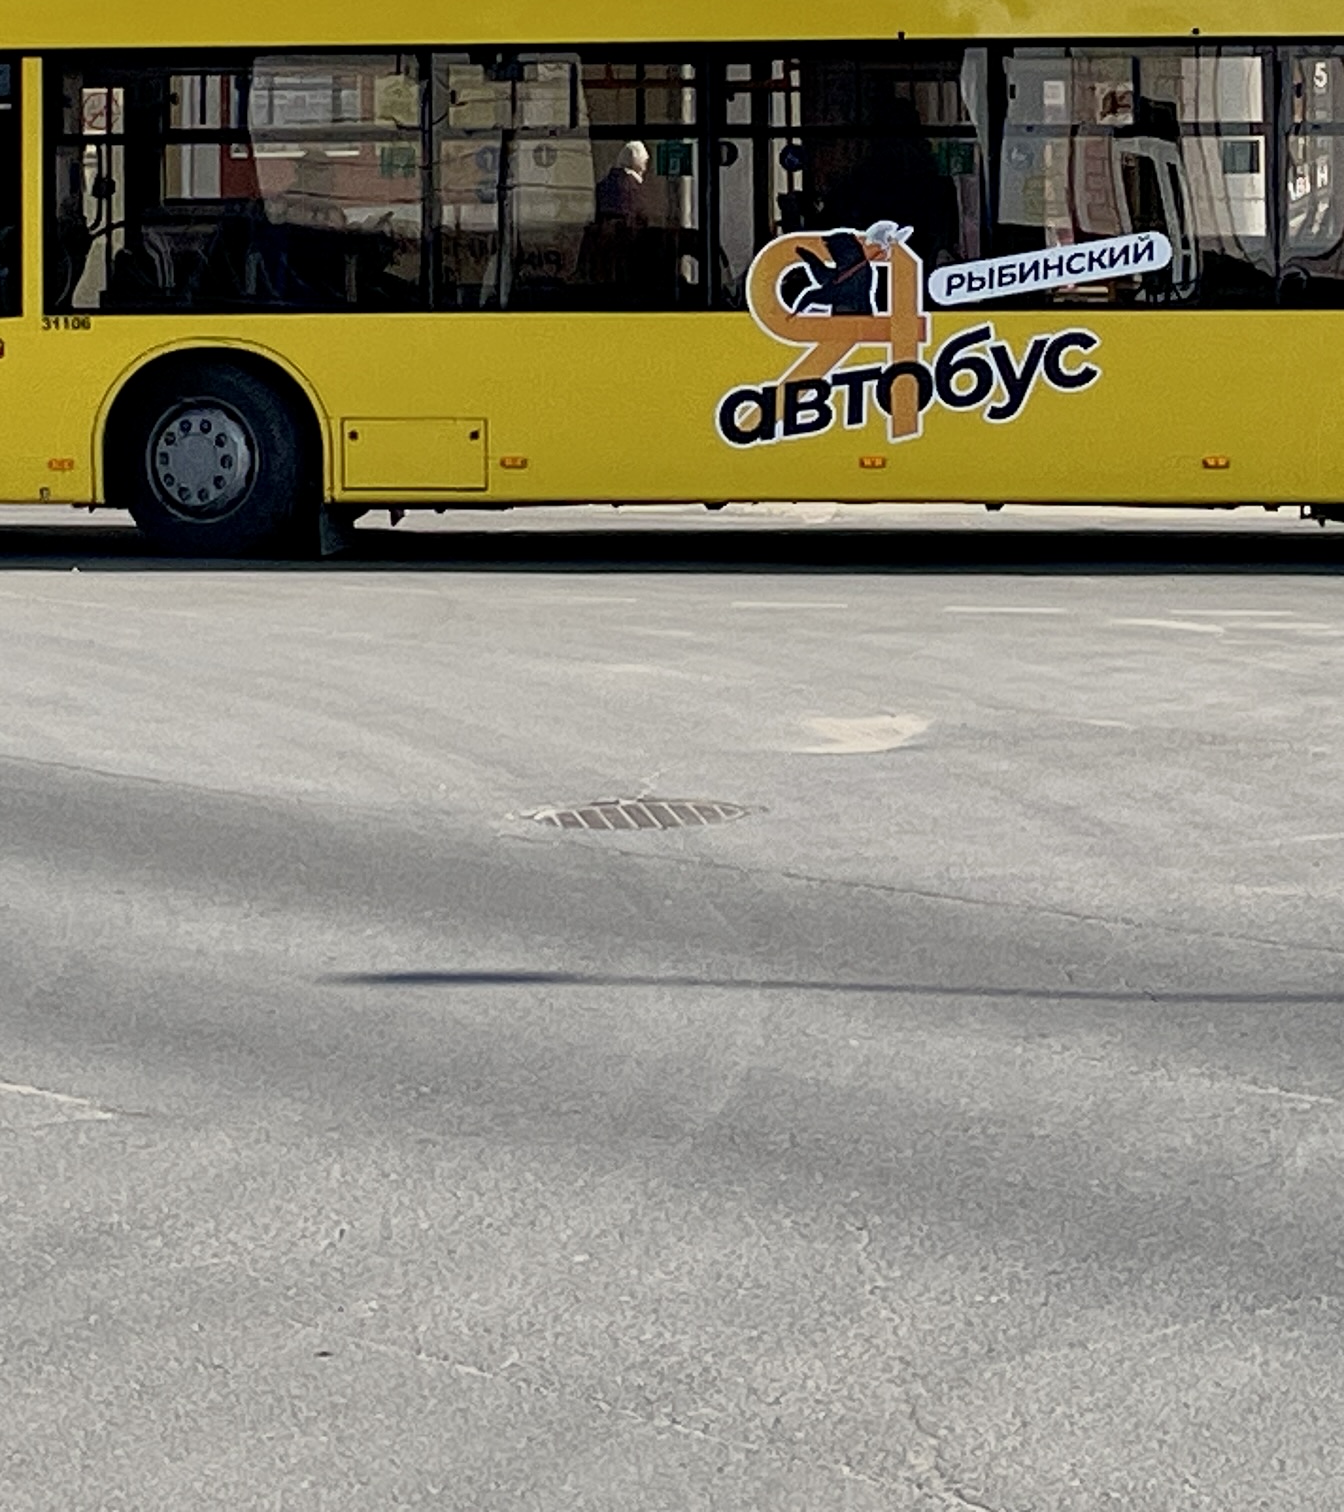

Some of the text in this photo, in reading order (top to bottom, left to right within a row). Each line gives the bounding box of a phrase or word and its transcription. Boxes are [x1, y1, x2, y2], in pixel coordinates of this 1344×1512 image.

[945, 234, 1155, 297] РЫБИНСКИЙ
[41, 316, 91, 331] 31106
[718, 324, 1098, 442] автобус
